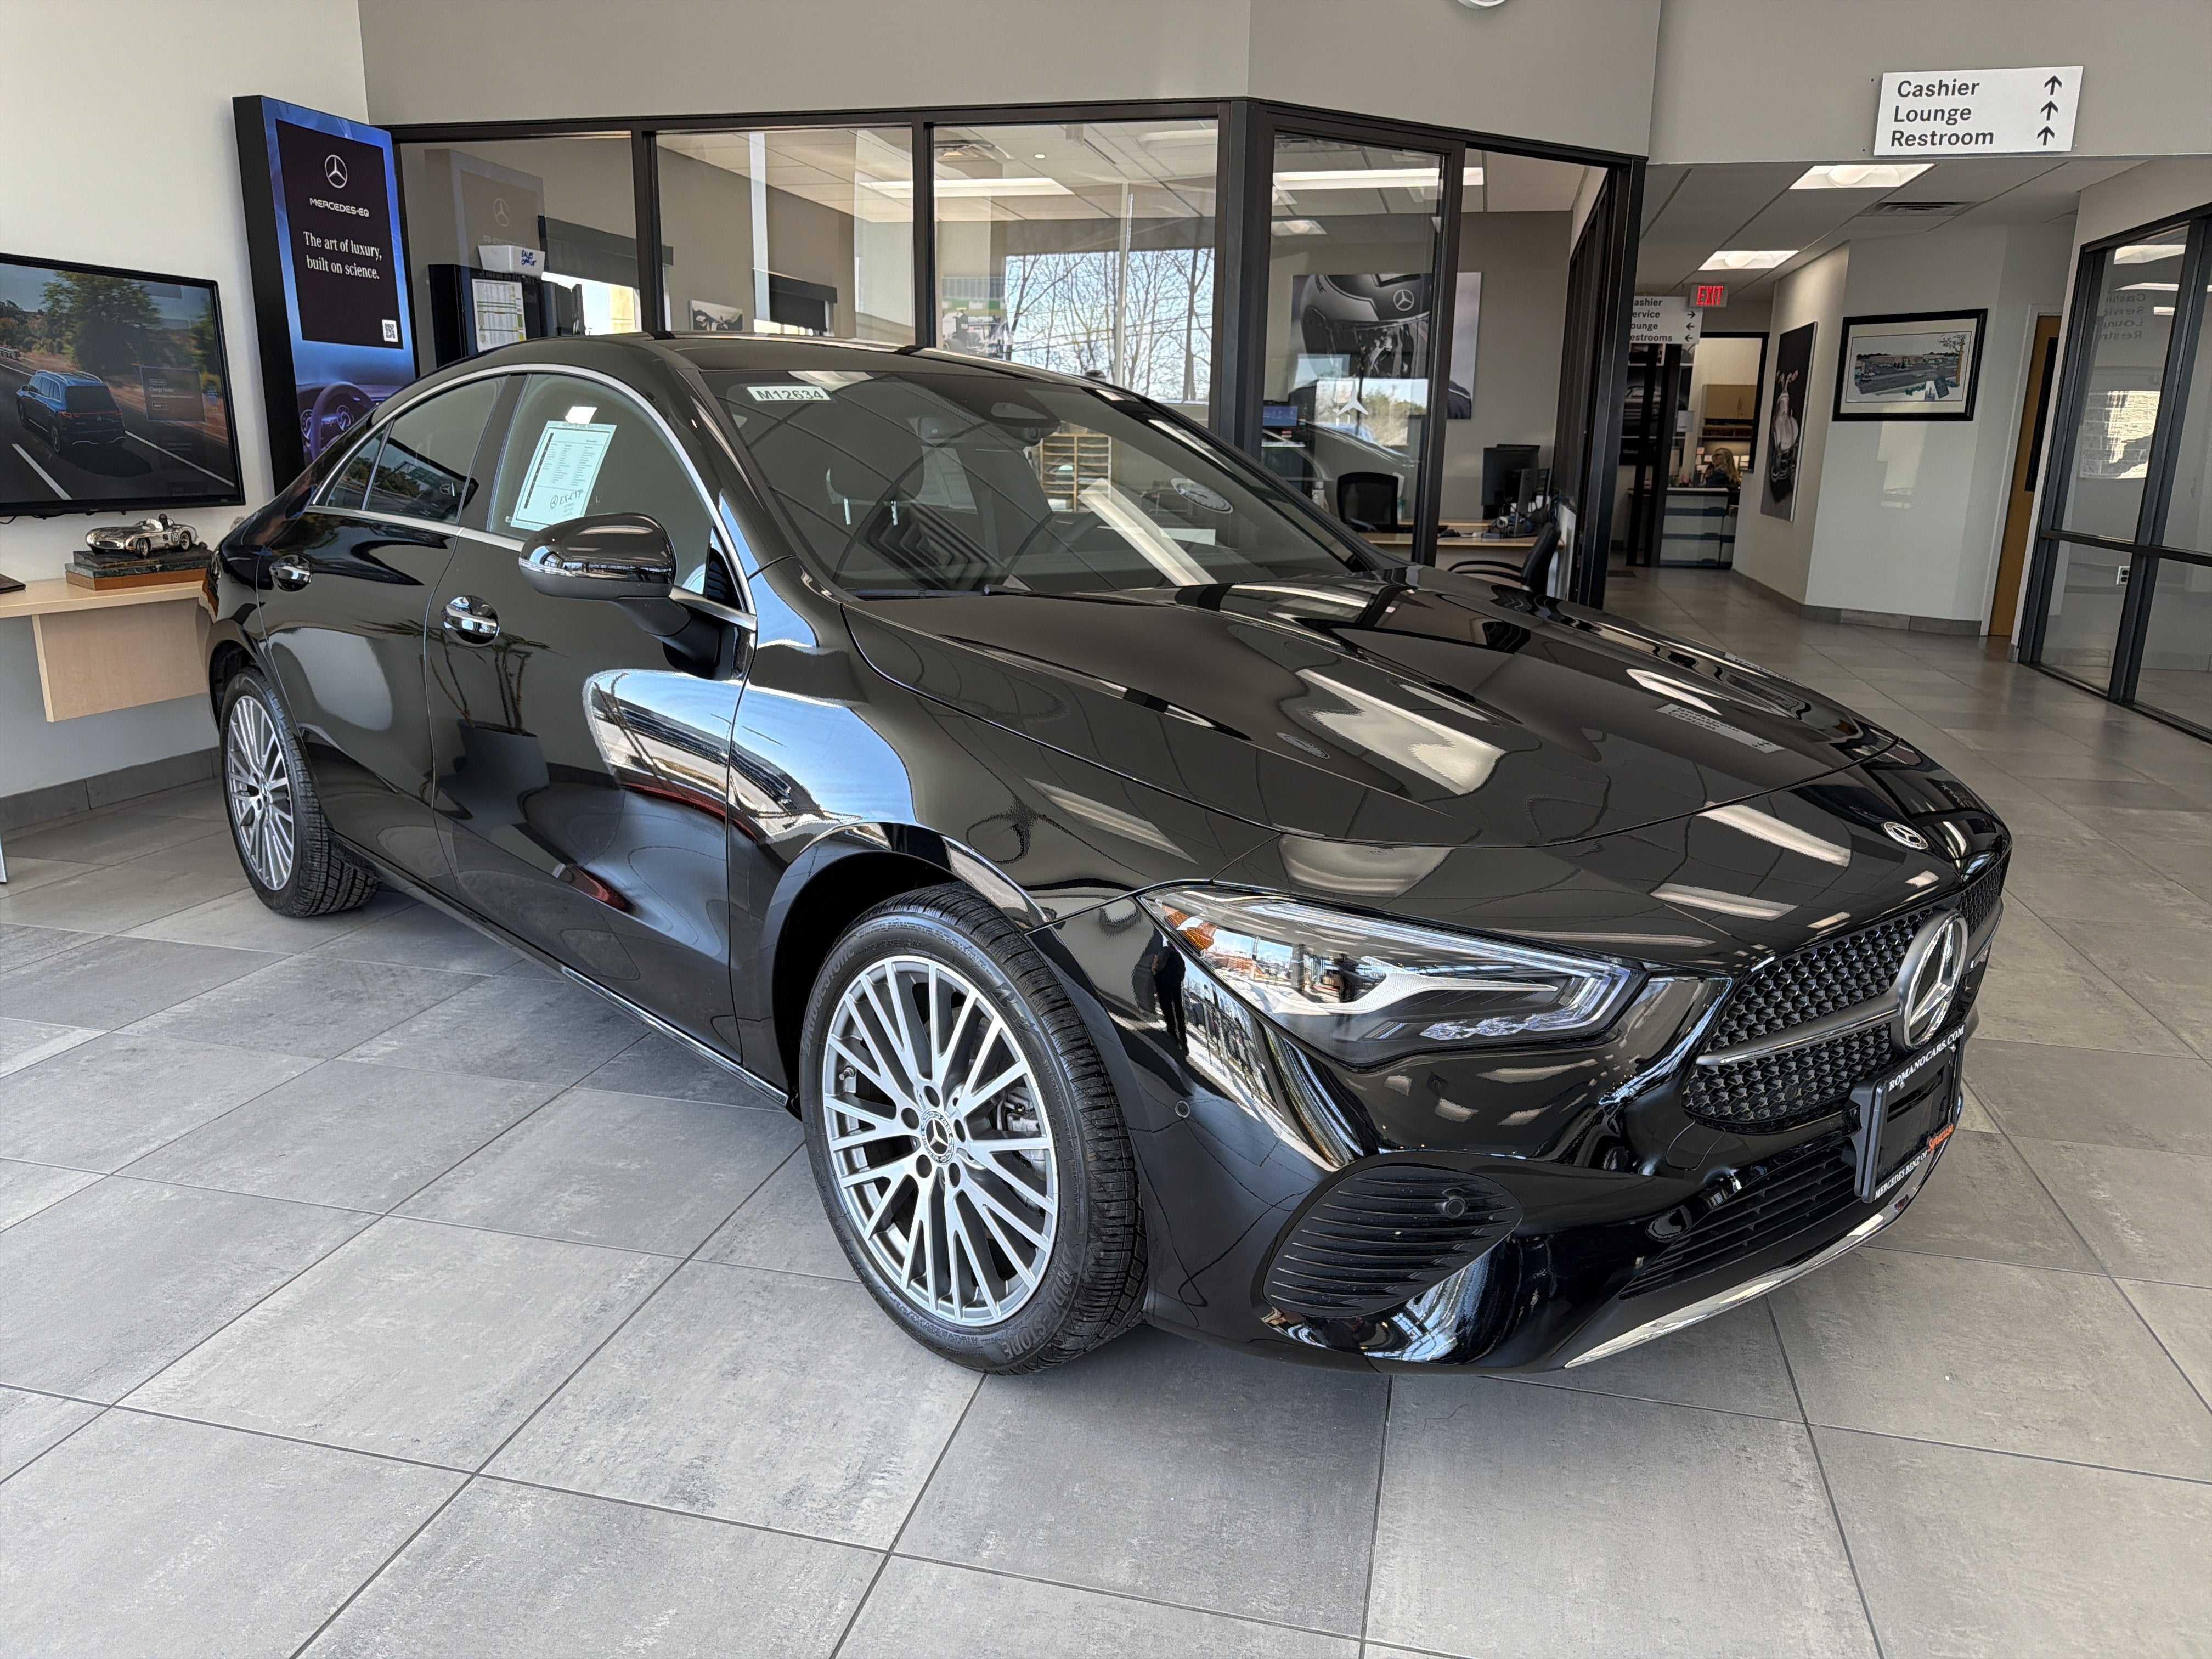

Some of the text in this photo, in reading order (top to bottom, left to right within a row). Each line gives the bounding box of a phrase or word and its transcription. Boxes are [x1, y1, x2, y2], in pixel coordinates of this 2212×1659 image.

[1897, 78, 1980, 98] Cashier
[1894, 105, 1972, 126] Lounge
[1891, 129, 1994, 147] Restroom
[303, 231, 382, 261] The art of luxury,
[306, 255, 380, 279] built on science.
[1634, 298, 1663, 307] ashier
[1696, 286, 1724, 306] EXIT
[1632, 310, 1660, 318] ervice
[1631, 323, 1658, 331] ounge
[755, 390, 824, 400] M12634
[802, 940, 855, 1057] BRIDGESTONE
[1888, 1024, 1965, 1093] ROMANOCARS.COM
[1875, 1168, 1905, 1200] MERCEDES
[1905, 1156, 1920, 1175] BENZ
[1921, 1150, 1928, 1161] OF
[1001, 1241, 1080, 1360] BRIDGESTONE
